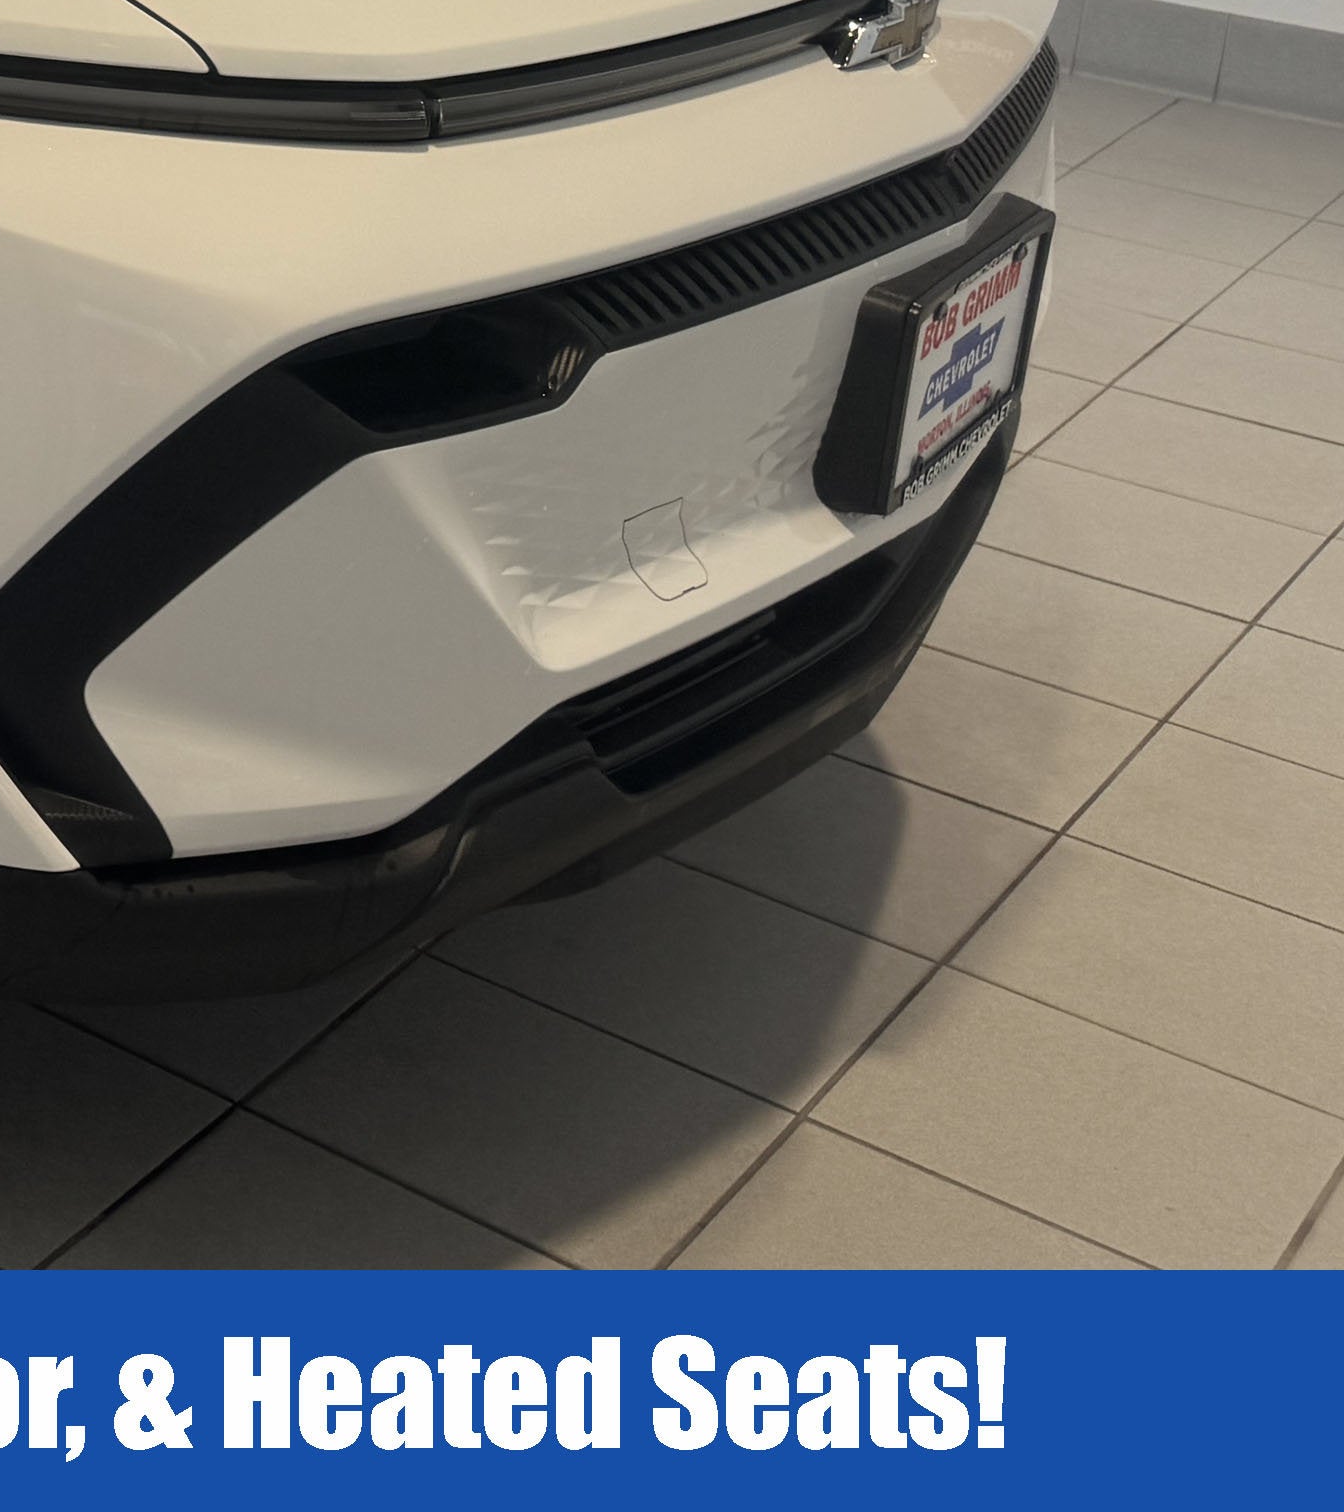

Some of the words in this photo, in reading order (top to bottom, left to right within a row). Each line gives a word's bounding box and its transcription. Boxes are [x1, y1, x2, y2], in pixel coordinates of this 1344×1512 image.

[920, 302, 960, 360] BOB
[962, 261, 1022, 327] GRIMM
[925, 330, 997, 405] CHEVROLET
[903, 472, 926, 502] BOB
[960, 399, 1013, 457] CHEVROLET
